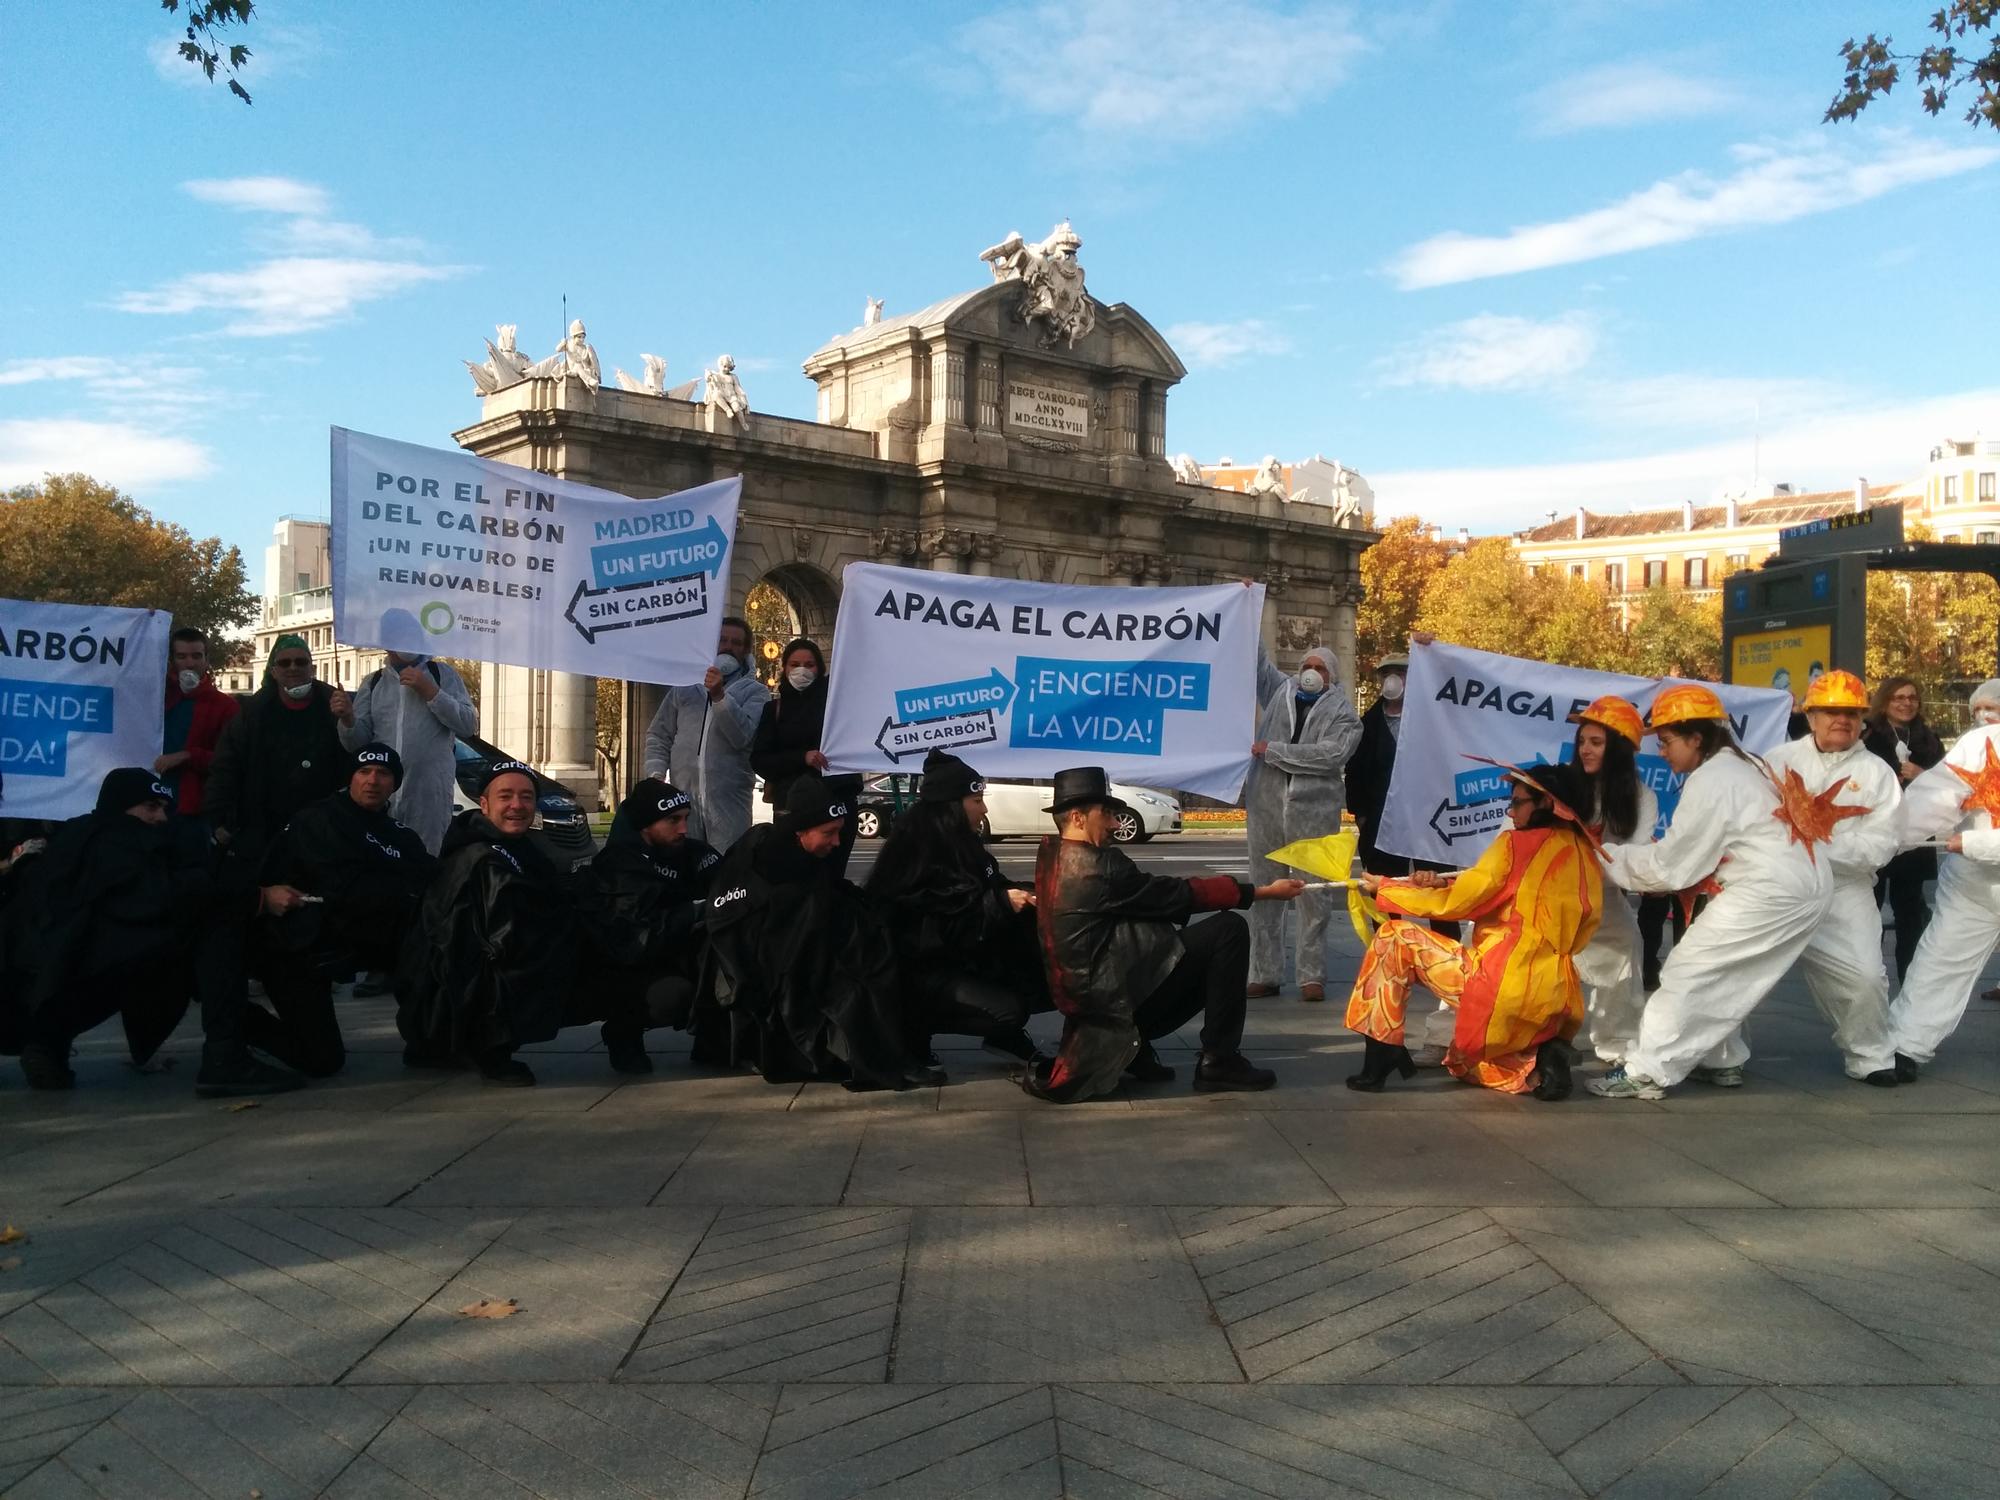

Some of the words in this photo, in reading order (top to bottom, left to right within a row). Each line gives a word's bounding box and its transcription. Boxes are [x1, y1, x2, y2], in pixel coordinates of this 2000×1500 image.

[1009, 384, 1036, 399] REGE
[1037, 390, 1076, 407] CAROLO
[1077, 398, 1088, 409] III
[1035, 403, 1065, 417] ANNO
[1015, 412, 1083, 433] MDCCLXXVIII
[376, 471, 441, 499] POR
[454, 482, 491, 506] EL
[505, 488, 556, 514] FIN
[362, 500, 423, 527] DEL
[436, 509, 565, 545] CARBÓN
[594, 509, 695, 541] MADRID
[368, 536, 411, 555] ¡UN
[421, 542, 517, 568] FUTURO
[526, 555, 555, 573] DE
[602, 556, 634, 576] UN
[639, 541, 719, 572] FUTURO
[378, 567, 542, 601] RENOVABLES!
[589, 601, 620, 618] SIN
[624, 587, 699, 613] CARBÓN
[874, 589, 1001, 632] APAGA
[1011, 605, 1052, 637] EL
[1062, 606, 1222, 642] CARBÓN
[457, 613, 489, 626] Amigos
[461, 623, 470, 631] la
[472, 624, 497, 635] Tierra
[0, 626, 126, 667] ARBÓN
[904, 699, 930, 714] UN
[933, 685, 1005, 710] FUTURO
[1028, 669, 1196, 703] ¡ENCIENDE
[1435, 675, 1555, 722] APAGA
[894, 732, 920, 746] SIN
[922, 720, 987, 740] CARBÓN
[1027, 713, 1063, 739] LA
[1071, 715, 1153, 744] VIDA!
[0, 737, 56, 765] DA!
[358, 751, 389, 762] Coal
[1462, 780, 1479, 796] UN
[1449, 814, 1472, 827] SIN
